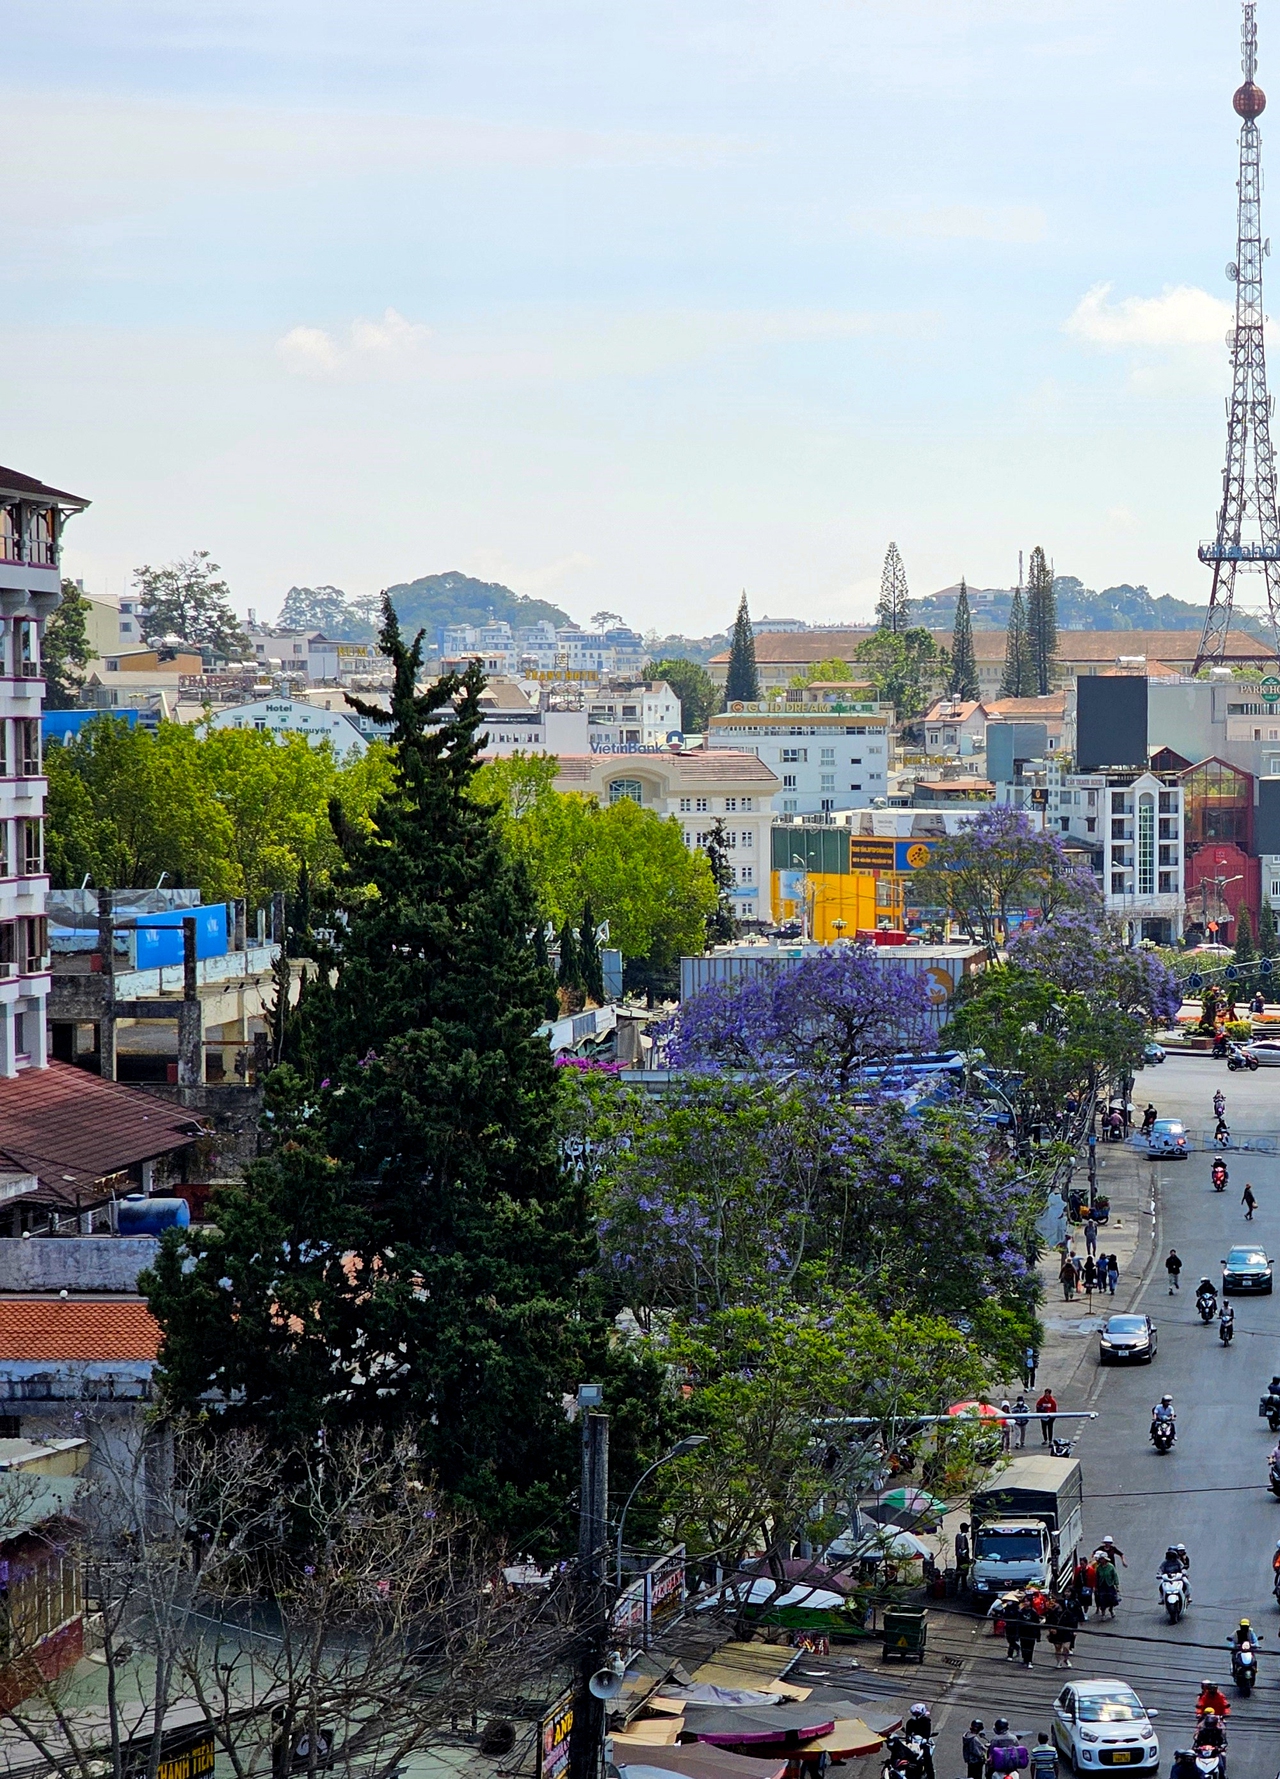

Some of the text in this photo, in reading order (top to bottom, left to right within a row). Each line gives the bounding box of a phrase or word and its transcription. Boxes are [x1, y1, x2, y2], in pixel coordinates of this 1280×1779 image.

[1240, 685, 1268, 694] PARK
[266, 704, 292, 712] Hotel
[747, 702, 874, 713] GOLD DREAM HOTEL
[589, 740, 663, 755] VietinBank
